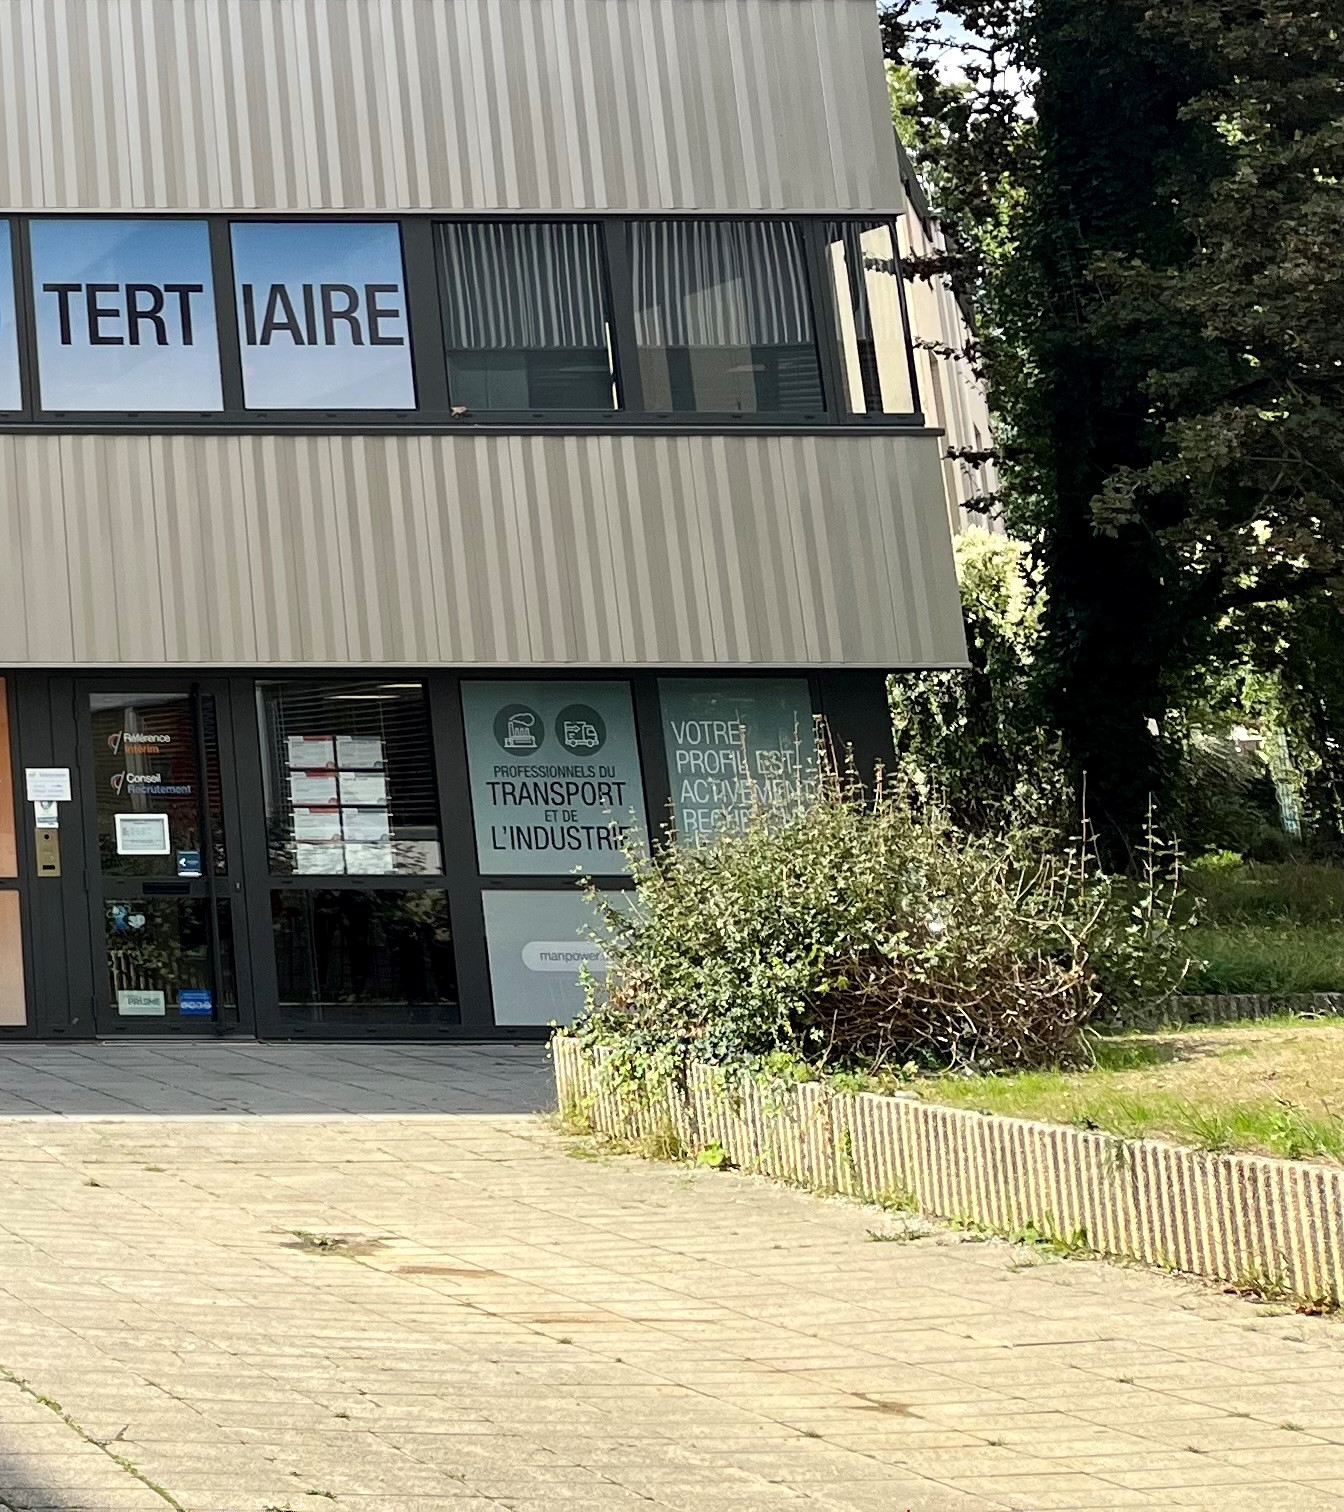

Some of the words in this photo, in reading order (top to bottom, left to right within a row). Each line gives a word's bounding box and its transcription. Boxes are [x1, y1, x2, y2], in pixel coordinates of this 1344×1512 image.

[42, 283, 203, 346] TERT
[241, 283, 404, 346] IAIRE
[671, 721, 742, 745] VOTRE
[494, 766, 595, 778] PROFESSIONNELS
[599, 766, 616, 778] DU
[676, 750, 749, 774] PROFIL
[126, 773, 161, 783] Conseil
[486, 781, 627, 806] TRANSPORT
[544, 810, 559, 822] ET
[563, 810, 578, 822] DE
